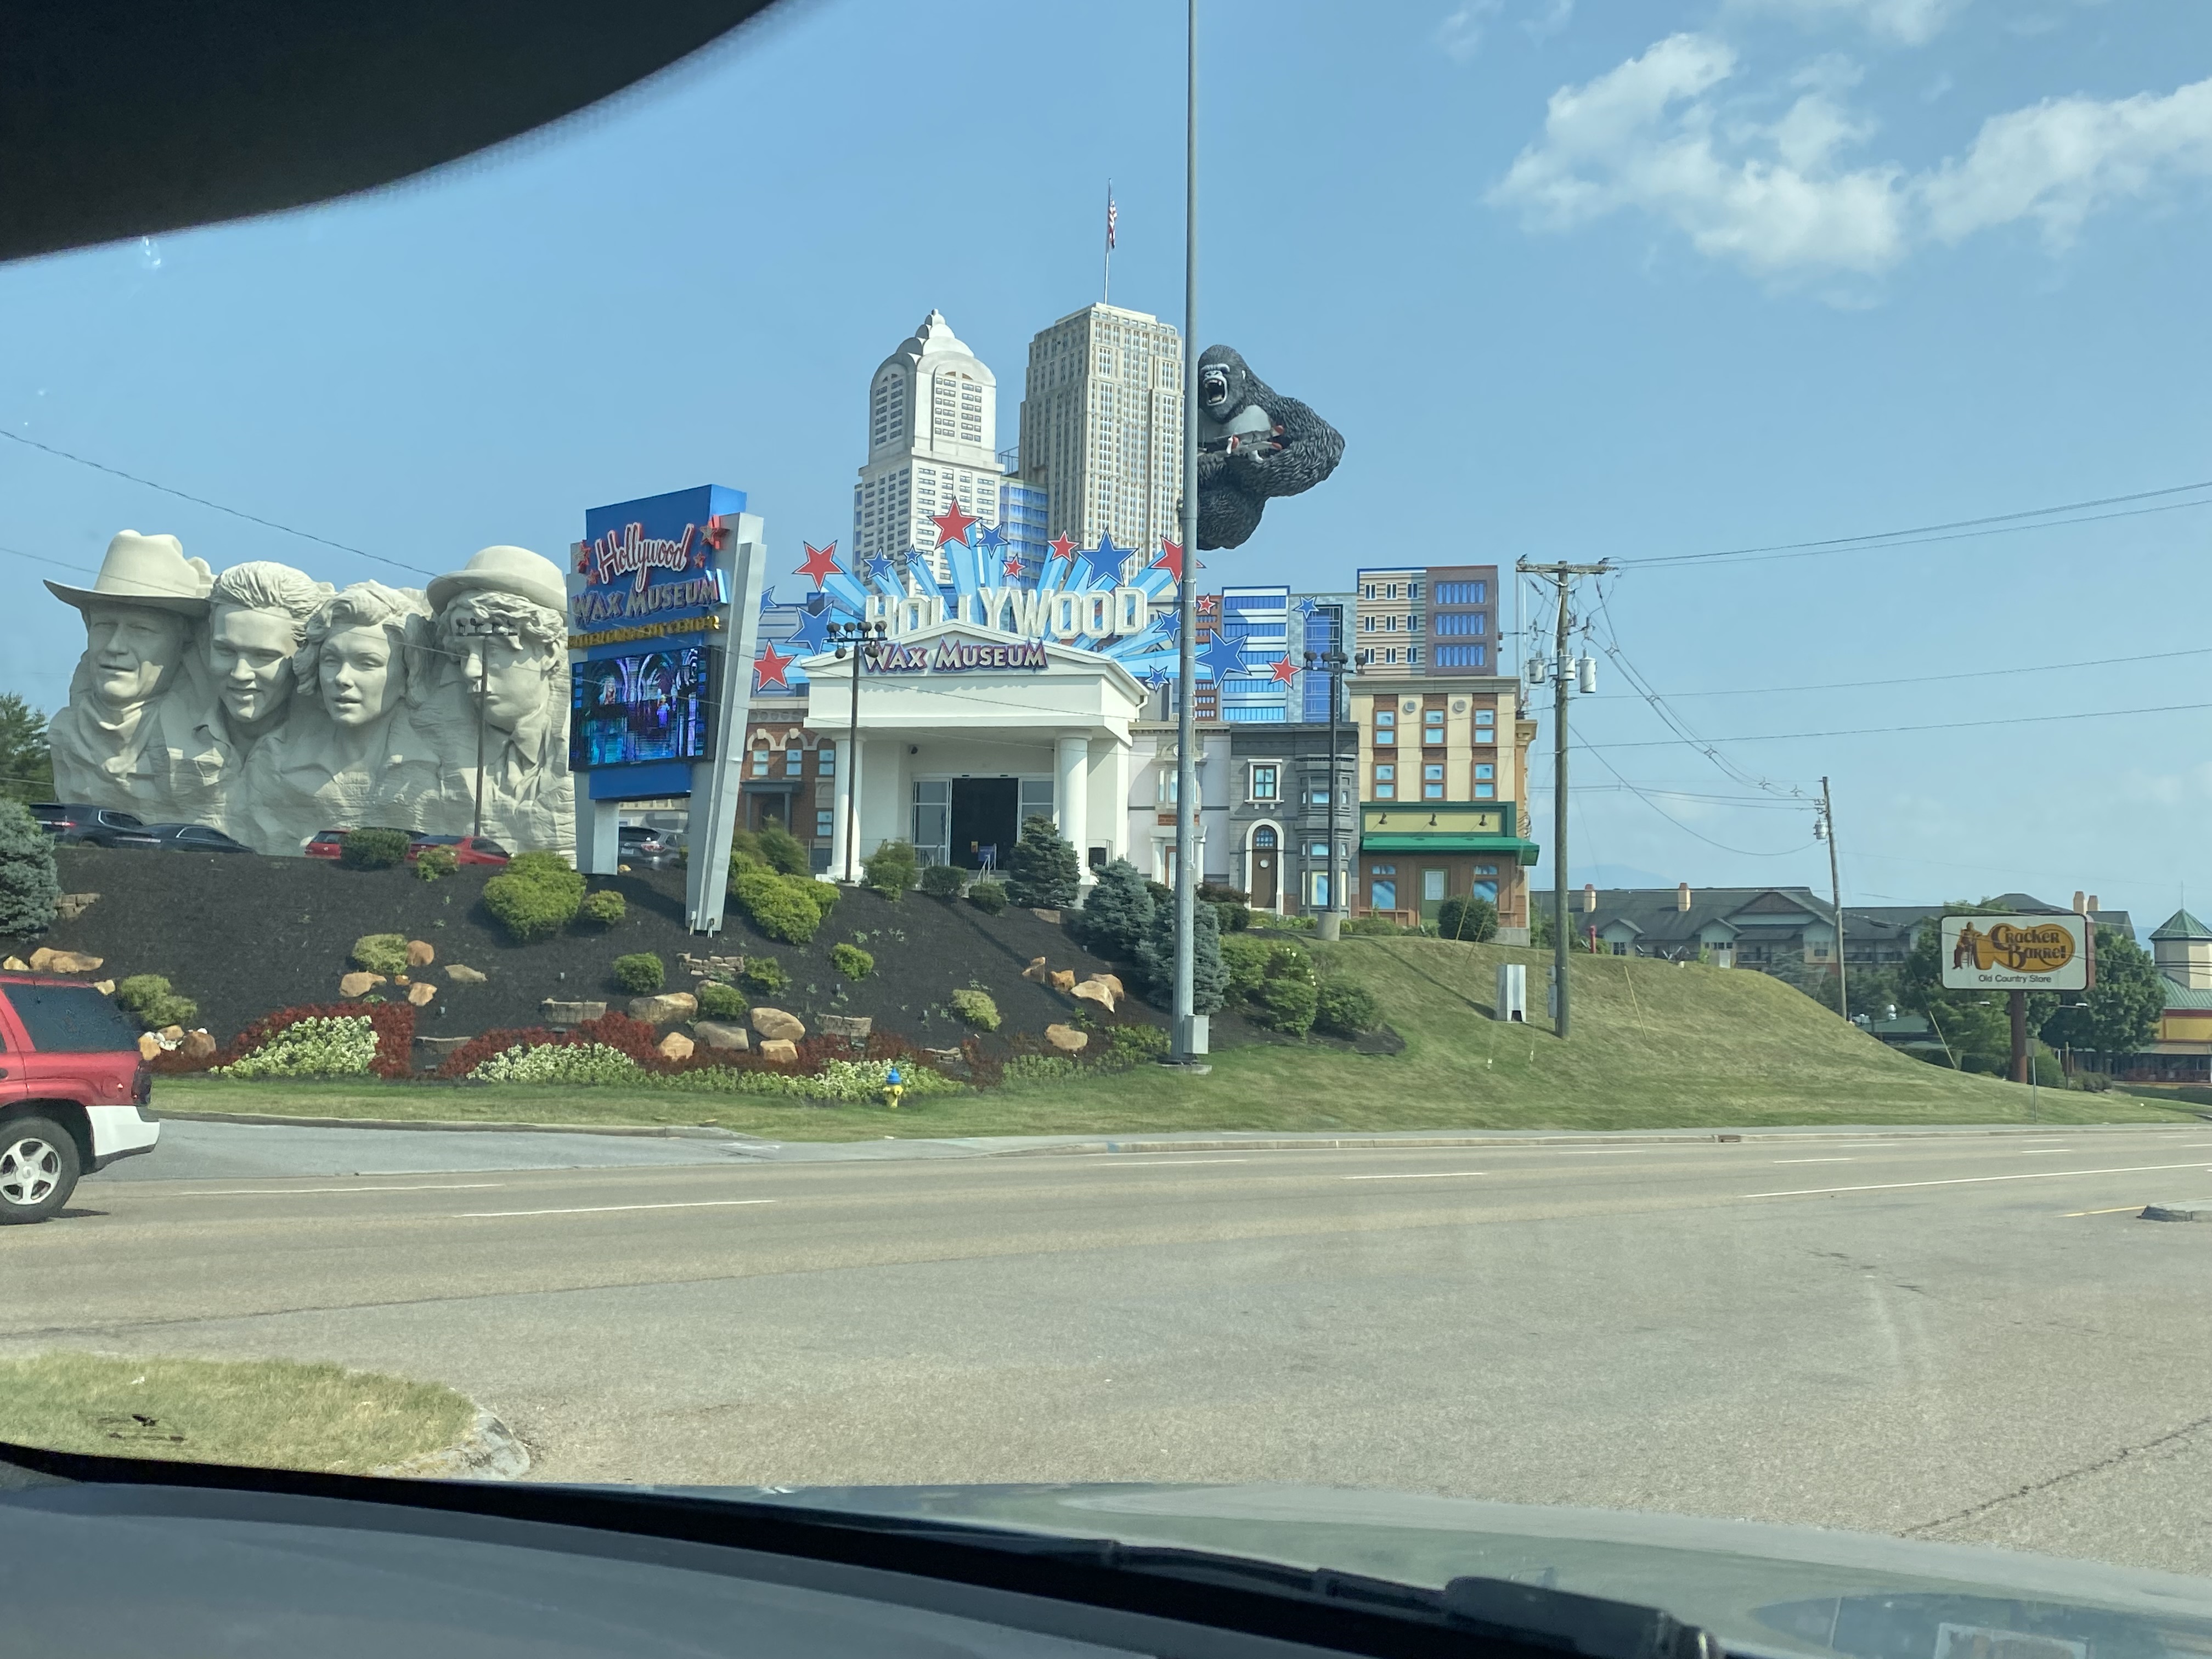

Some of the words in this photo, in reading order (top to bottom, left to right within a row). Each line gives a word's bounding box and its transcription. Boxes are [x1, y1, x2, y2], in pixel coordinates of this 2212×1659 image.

[595, 522, 695, 592] Hollywood
[571, 590, 625, 628] WAX
[624, 574, 720, 618] MUSEUM
[861, 641, 928, 674] WAX
[934, 635, 1048, 674] MUSEUM
[1995, 975, 2027, 984] Country
